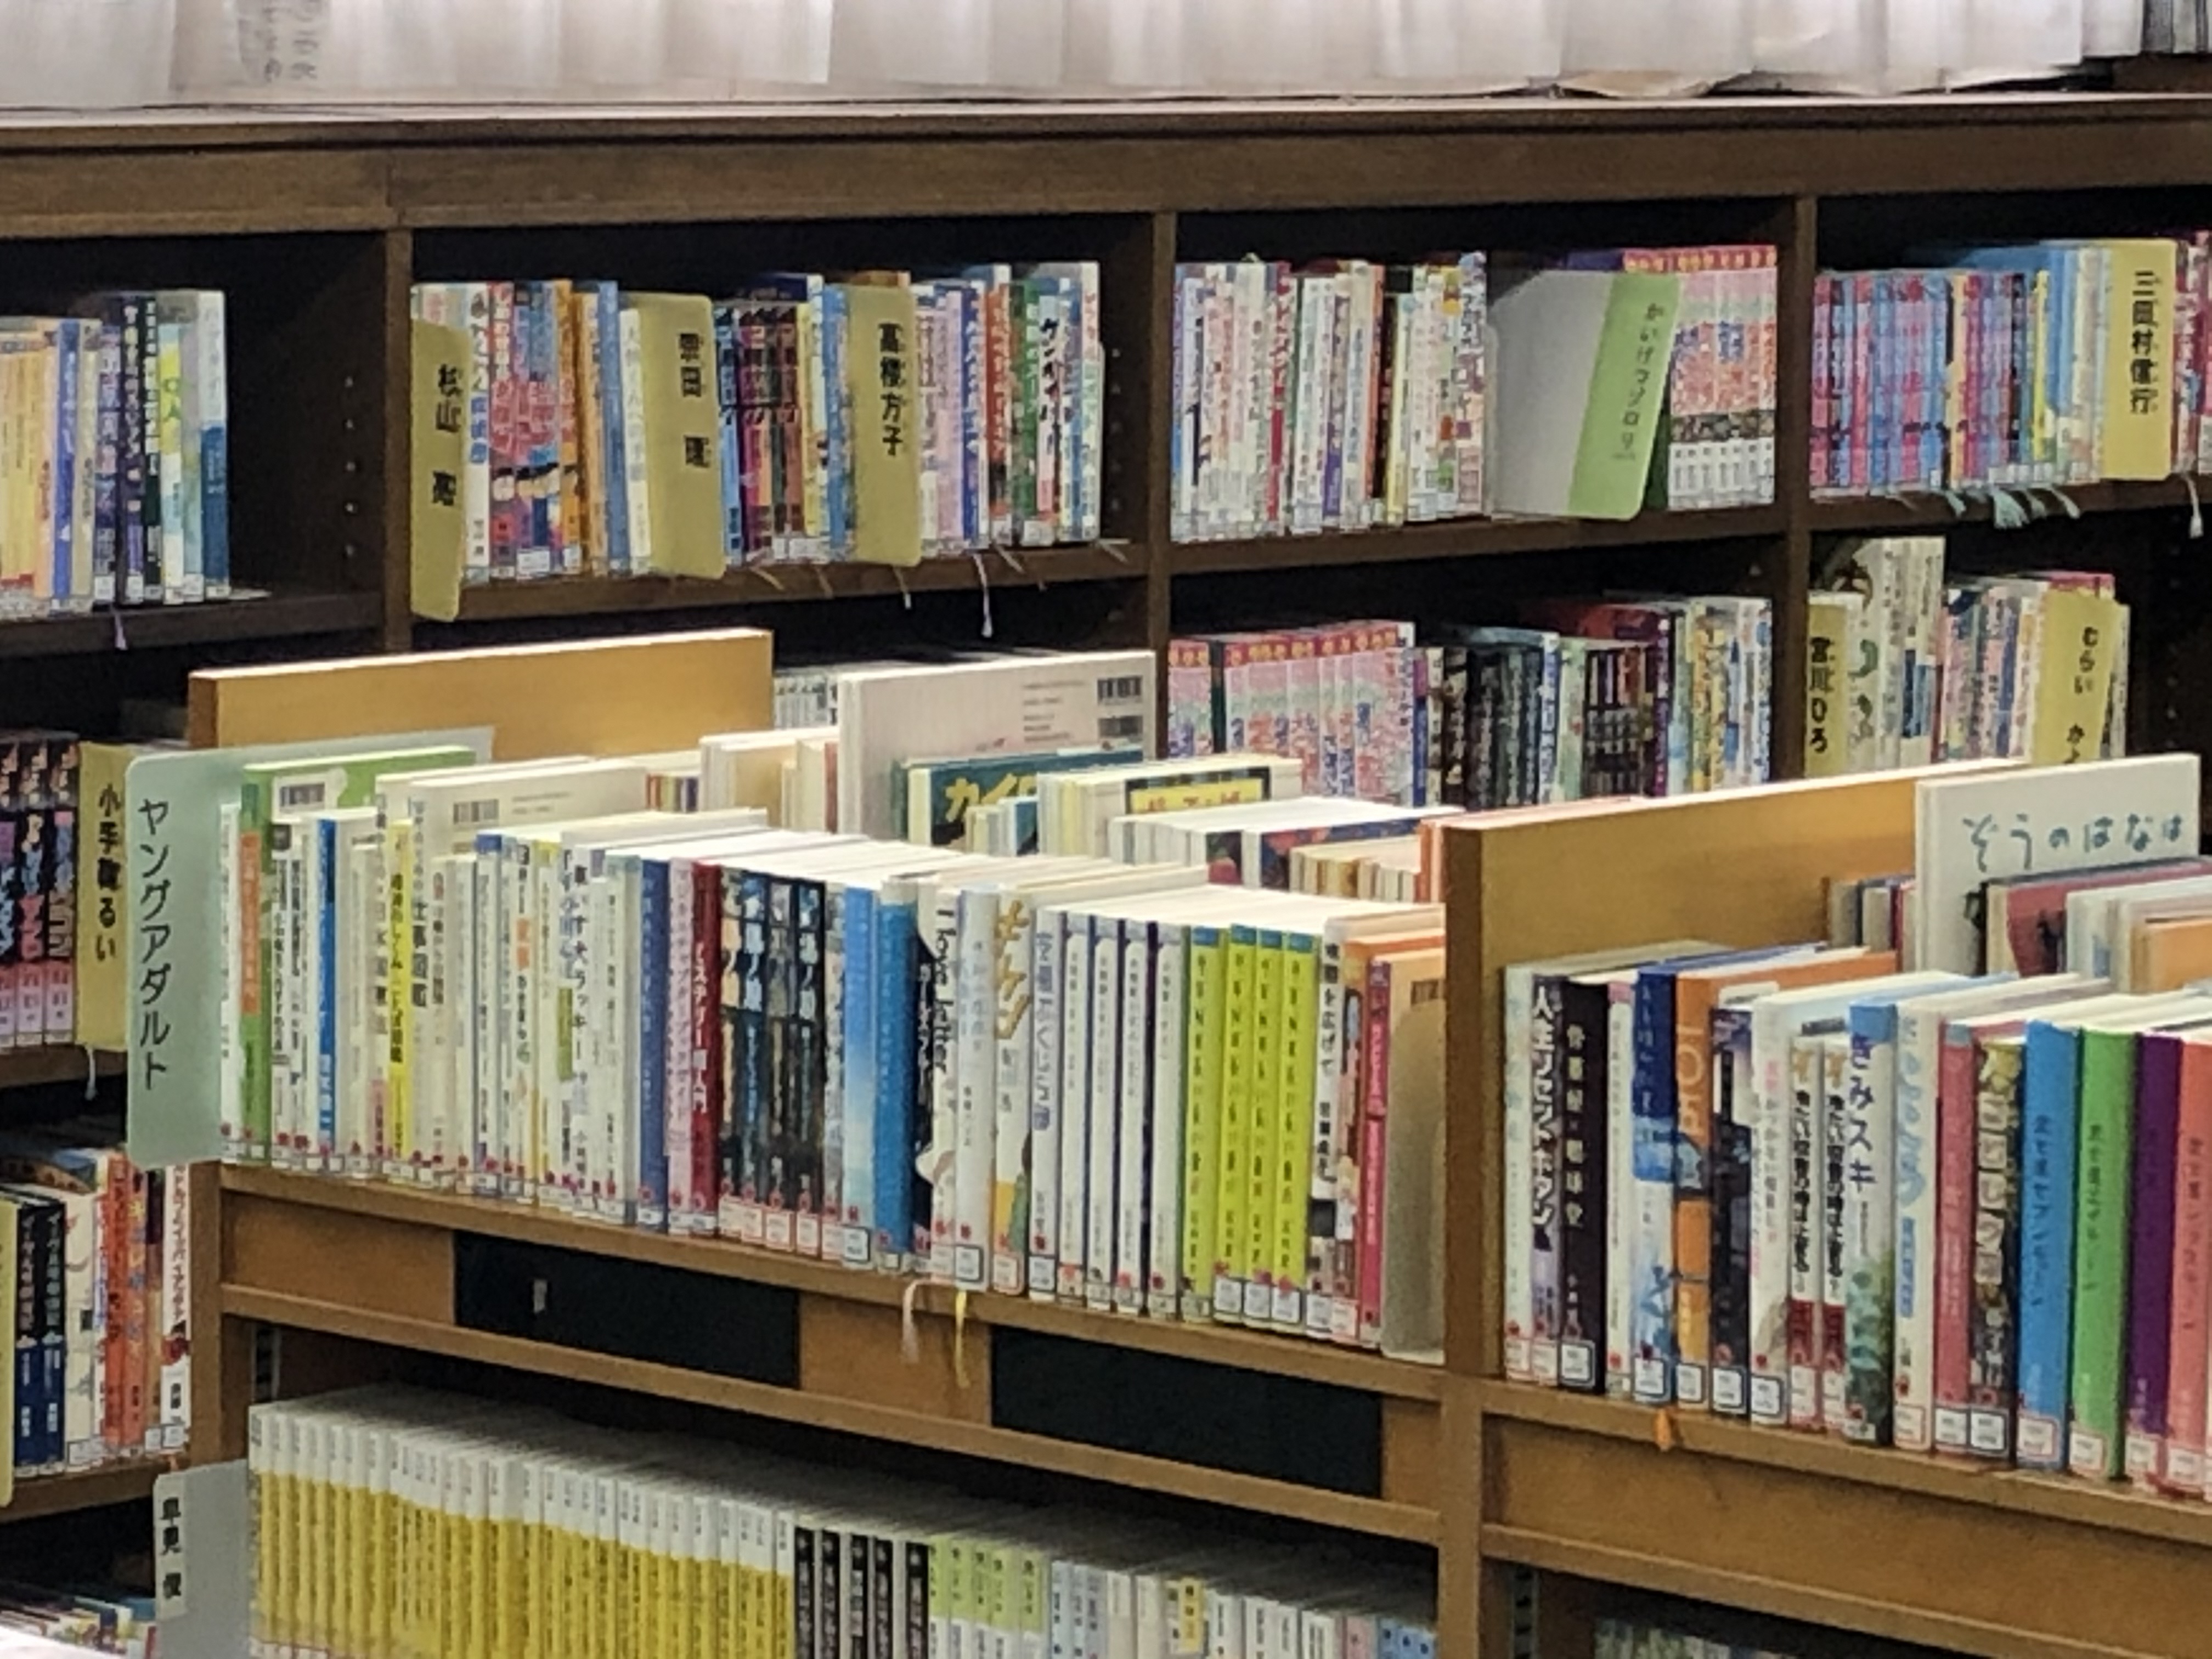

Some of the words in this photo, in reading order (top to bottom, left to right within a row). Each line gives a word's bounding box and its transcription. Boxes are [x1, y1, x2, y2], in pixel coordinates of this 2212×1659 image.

[2130, 270, 2158, 415] 三田村信行
[1810, 638, 1833, 754] 宮川ひろ
[138, 798, 170, 1090] ヤングアダルト
[934, 928, 957, 985] love
[934, 1000, 954, 1074] letter
[1533, 985, 1554, 1226] 人生リセットボタン
